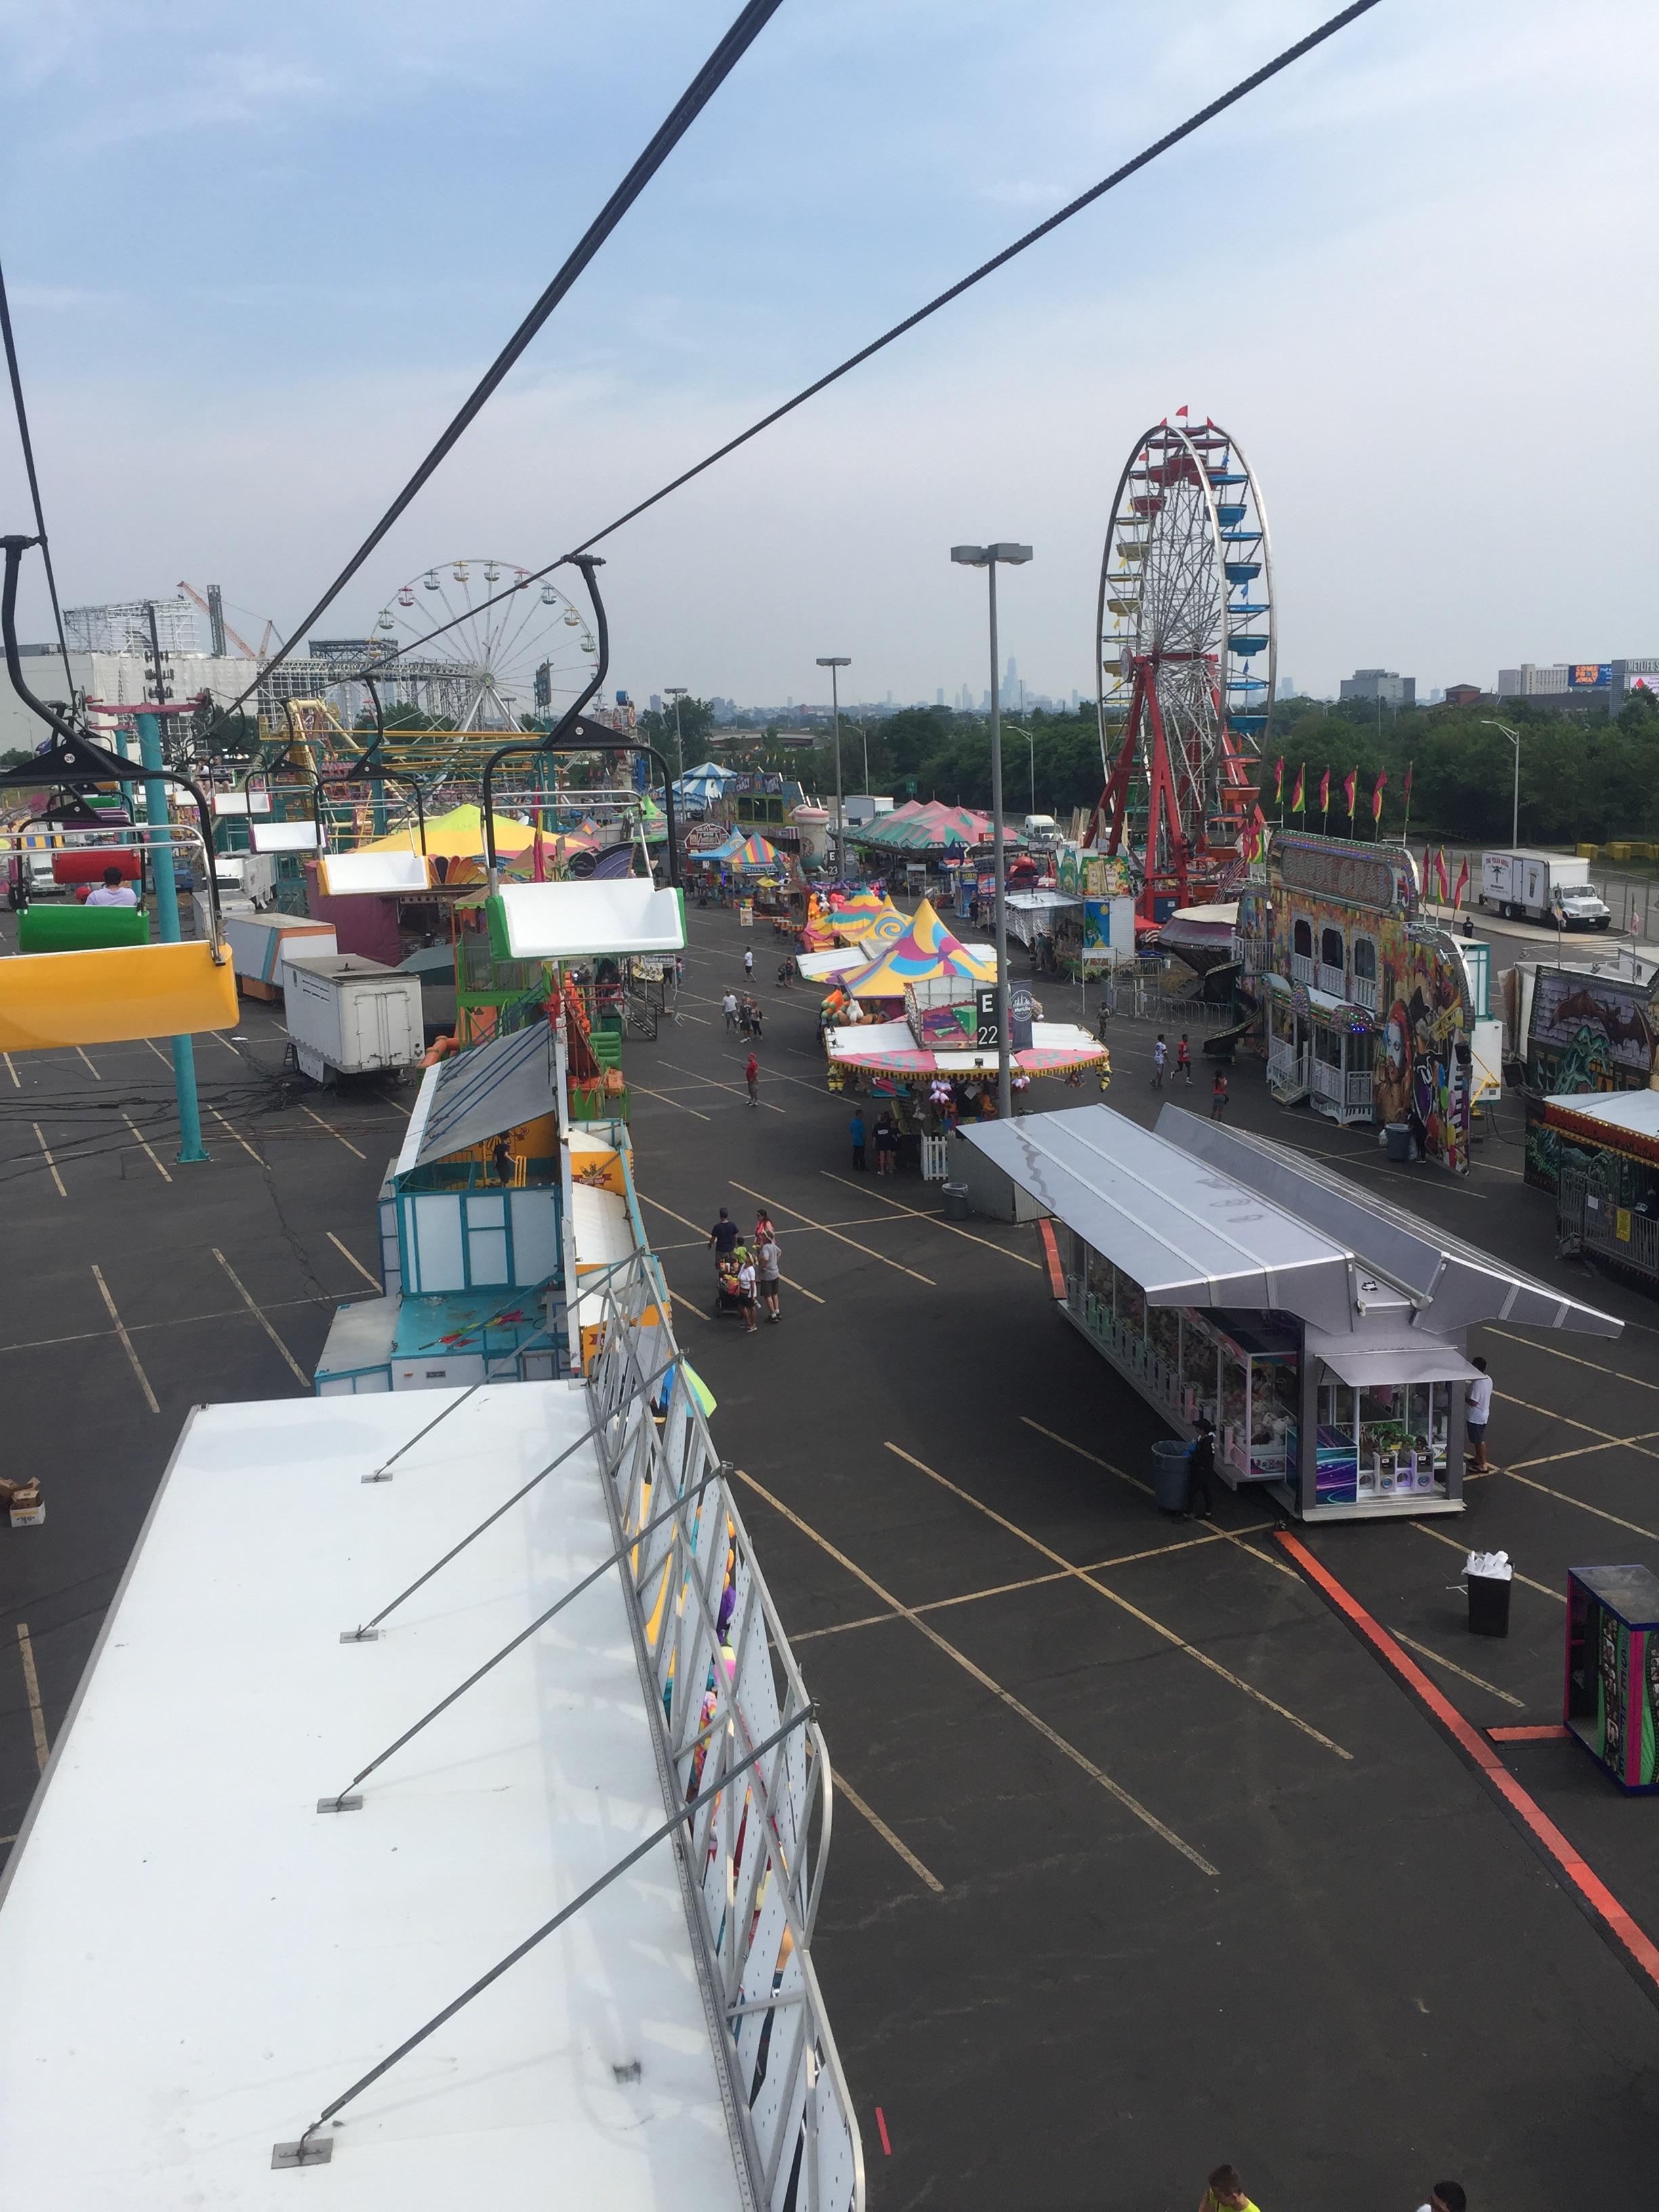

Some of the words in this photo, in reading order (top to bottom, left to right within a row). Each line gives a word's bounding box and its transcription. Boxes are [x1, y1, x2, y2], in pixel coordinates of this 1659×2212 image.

[1628, 661, 1654, 672] METLIFE
[830, 852, 836, 861] E
[828, 866, 838, 875] 23
[982, 994, 994, 1012] E
[978, 1025, 998, 1045] 22
